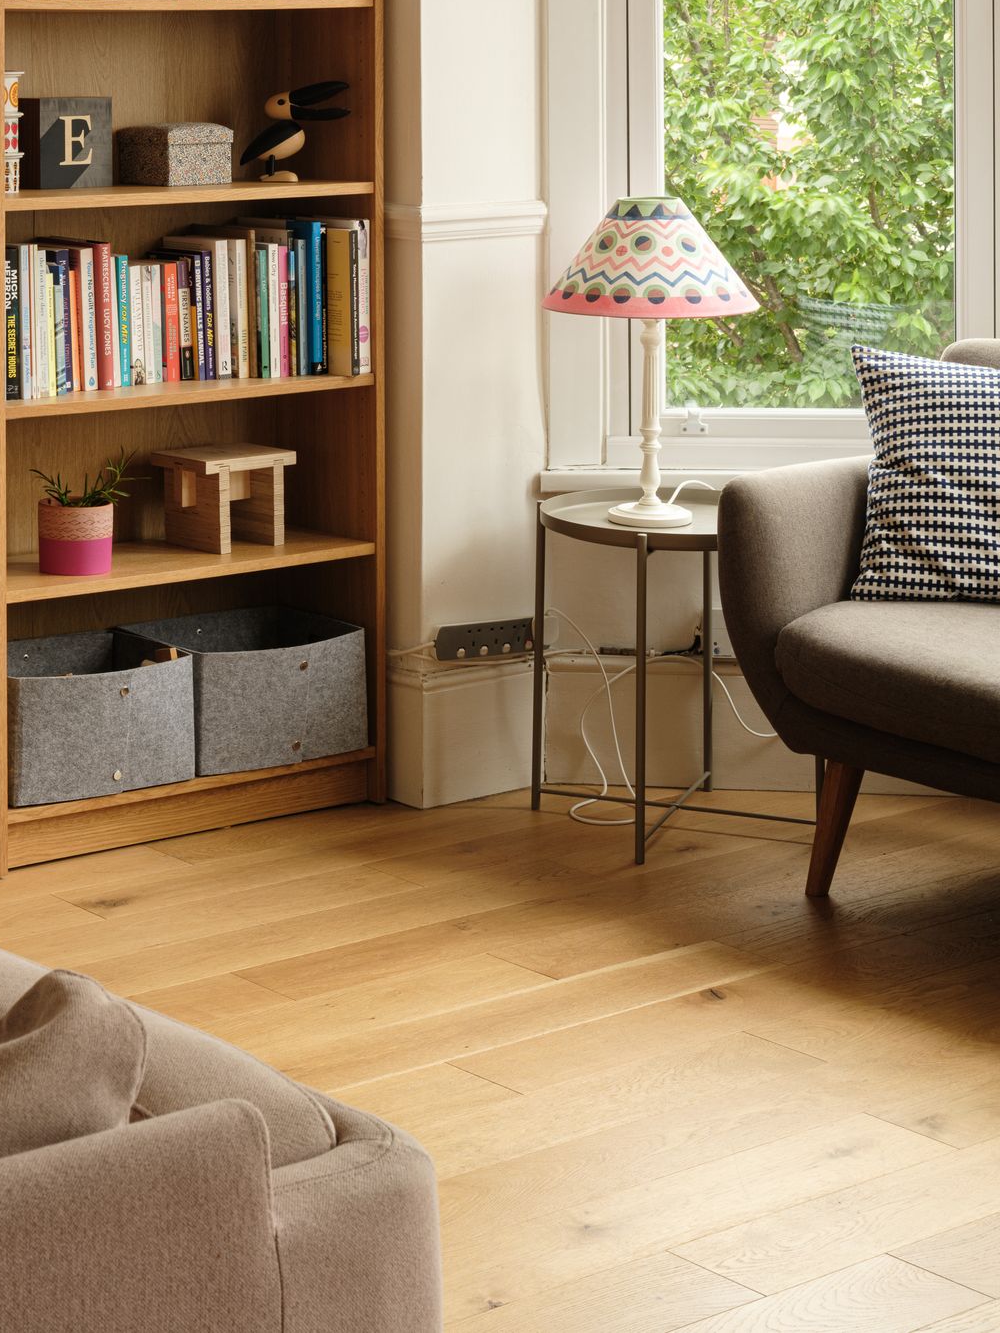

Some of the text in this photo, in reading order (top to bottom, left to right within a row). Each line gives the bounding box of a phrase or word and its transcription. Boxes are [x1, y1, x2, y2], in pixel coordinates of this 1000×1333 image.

[59, 115, 94, 166] E
[87, 279, 93, 293] No
[120, 260, 128, 303] Pregnancy
[196, 302, 204, 330] SKILLS
[279, 282, 288, 325] Basquiat
[7, 314, 16, 378] THE SECRET HOURS
[87, 311, 95, 351] Pregnancy
[197, 331, 205, 366] MANUAL
